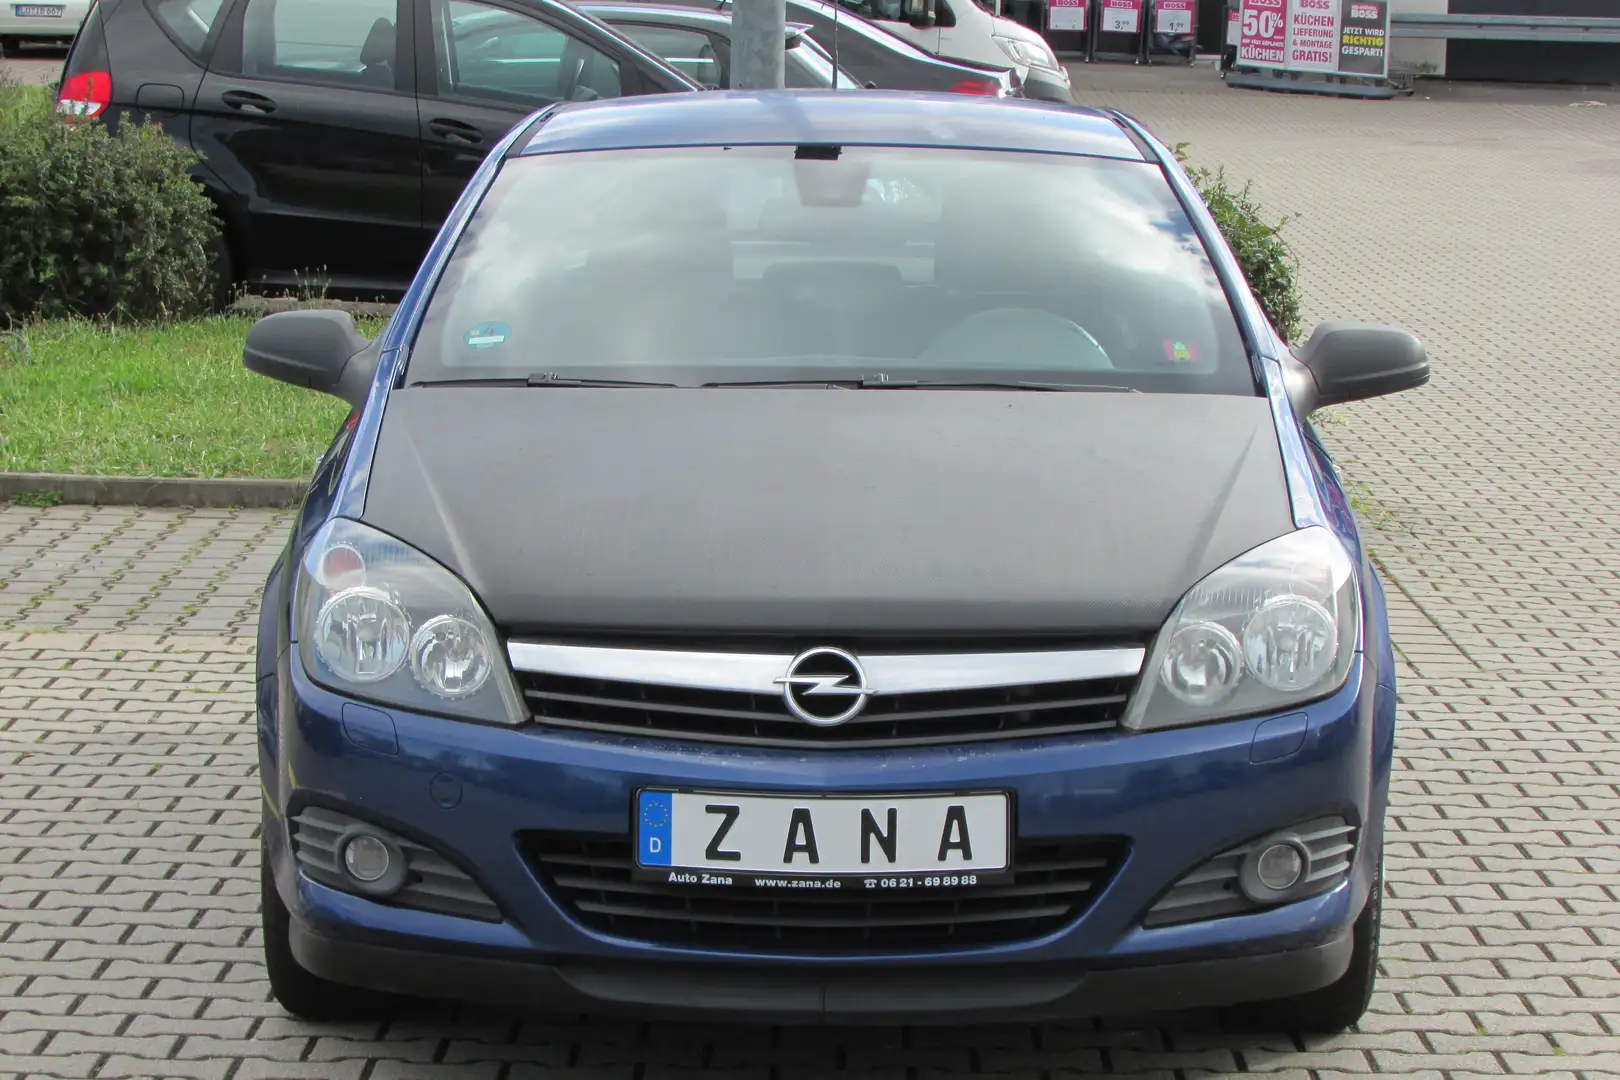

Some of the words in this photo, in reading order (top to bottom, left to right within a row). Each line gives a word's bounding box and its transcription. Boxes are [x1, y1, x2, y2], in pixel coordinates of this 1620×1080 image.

[1300, 0, 1330, 9] BOSS
[1293, 12, 1335, 27] KÜCHEN
[1351, 9, 1378, 19] BOSS
[1114, 20, 1130, 30] 3,99
[1242, 9, 1284, 38] 50%
[1293, 27, 1334, 39] LIEFERUNG
[1342, 27, 1363, 35] JETZT
[1364, 28, 1385, 36] WIRD
[1292, 38, 1298, 47] &
[1300, 39, 1333, 49] MONTAGE
[1342, 34, 1385, 46] RICHTIG
[1241, 45, 1284, 62] KÜCHEN
[1291, 50, 1333, 63] GRATIS!
[1341, 46, 1384, 57] GESPART!
[705, 804, 973, 864] ZANA
[649, 837, 662, 853] D
[668, 871, 698, 883] Auto
[701, 873, 733, 885] Zana
[754, 877, 841, 888] www.zana.de
